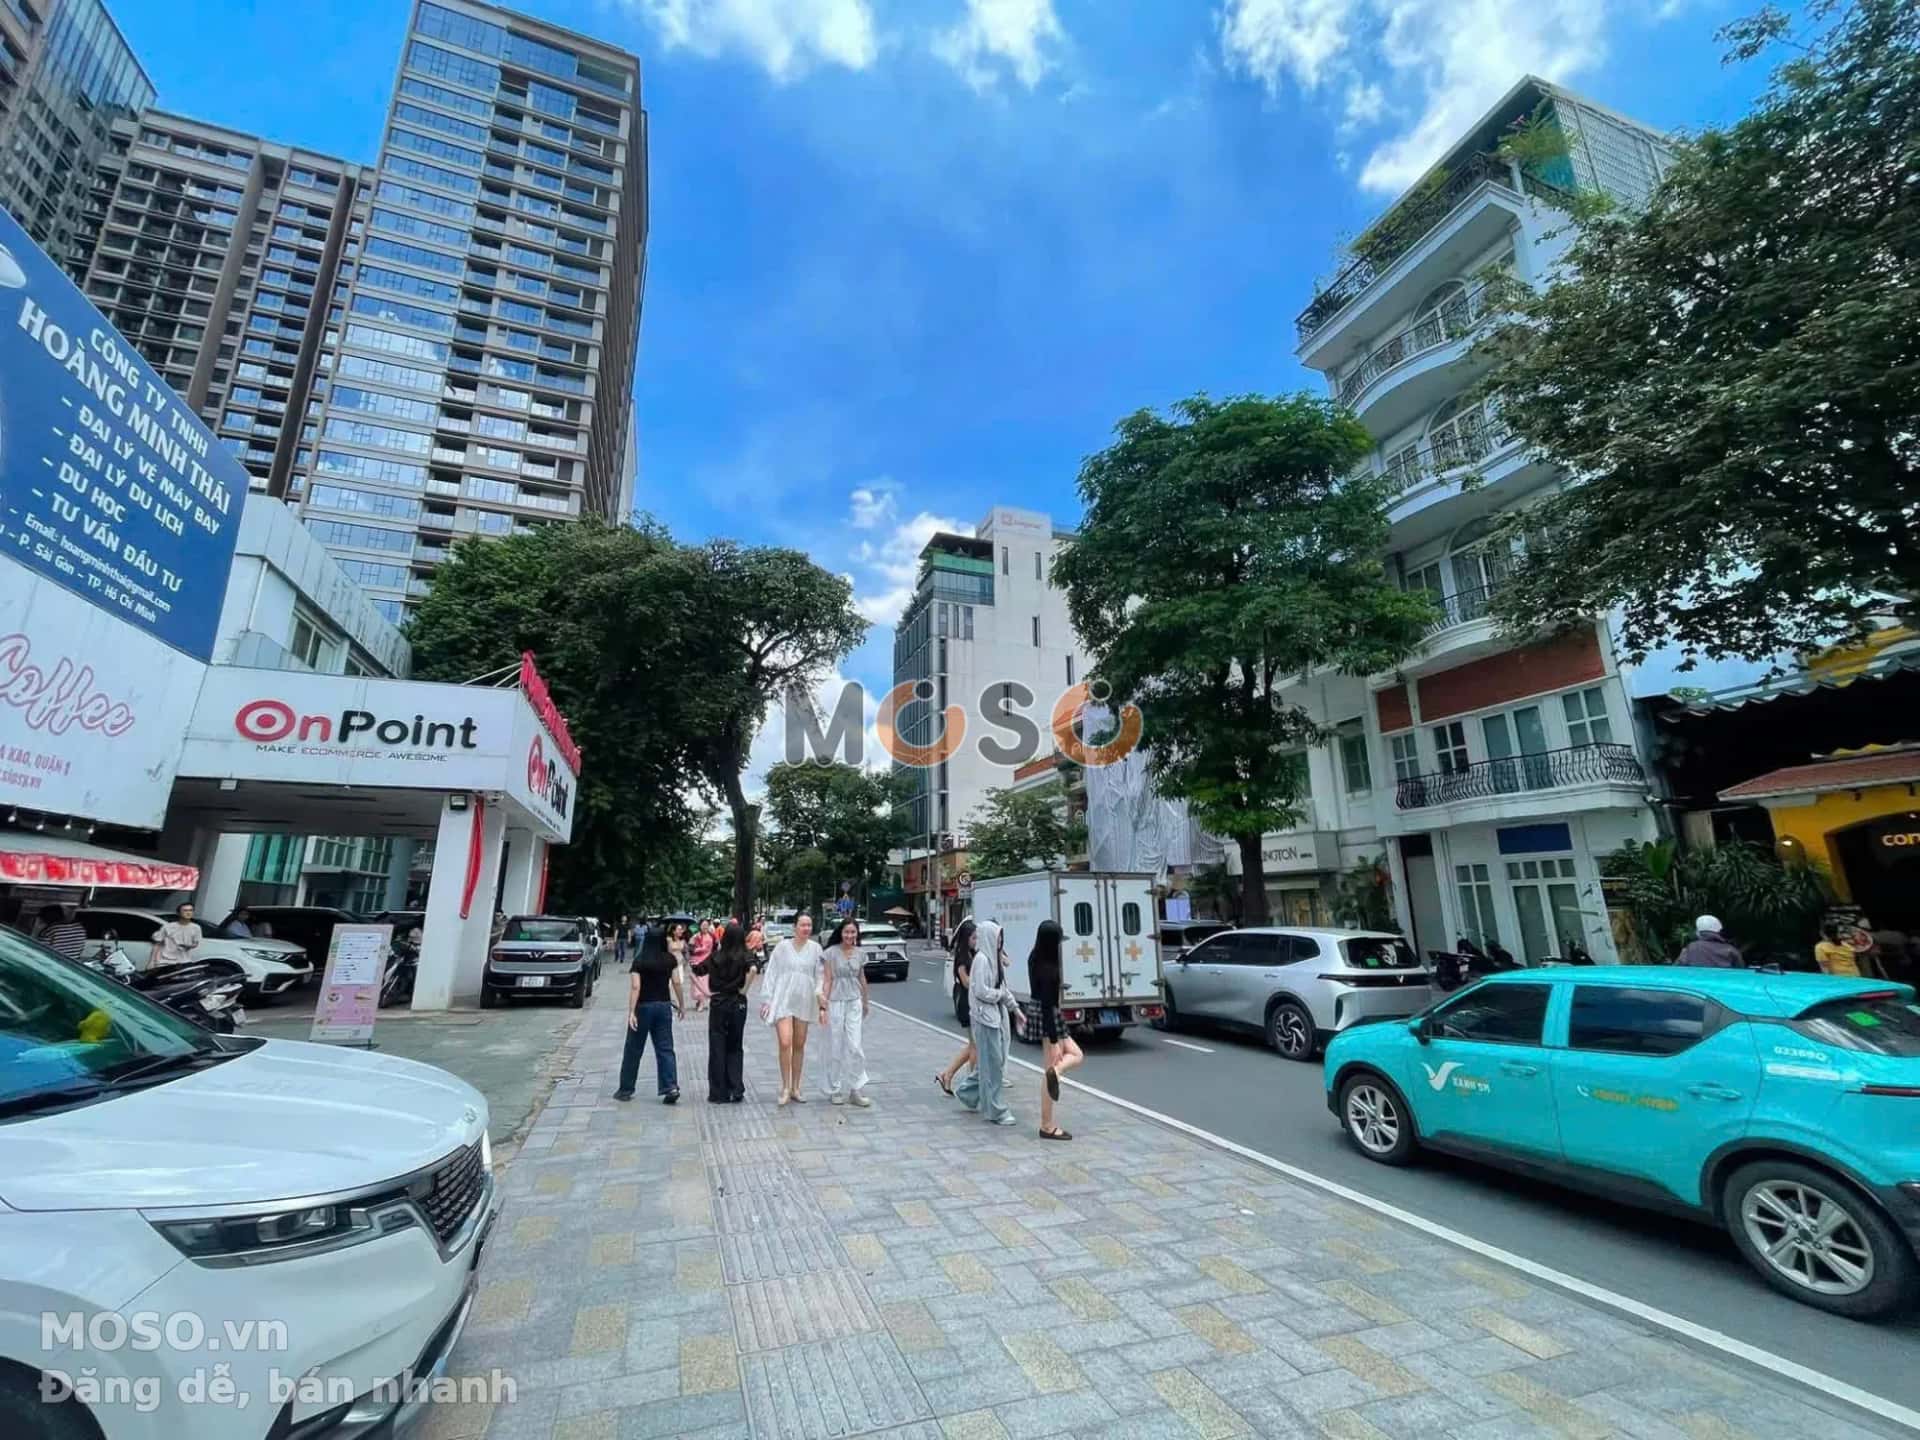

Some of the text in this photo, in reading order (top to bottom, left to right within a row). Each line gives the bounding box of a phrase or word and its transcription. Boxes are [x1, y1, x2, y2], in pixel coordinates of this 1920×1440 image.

[17, 296, 231, 515] HOÀNG MINH THÁI
[91, 328, 208, 458] CÔNG TY TNHH
[58, 461, 126, 523] DU HỌC
[69, 433, 184, 536] ĐẠI LÝ DU LỊCH
[79, 405, 220, 535] ĐẠI LÝ VÉ MÁY BAY
[51, 492, 81, 522] TƯ
[161, 568, 183, 592] TƯ
[256, 744, 448, 762] MAKE ECOMMERCE AWESOME
